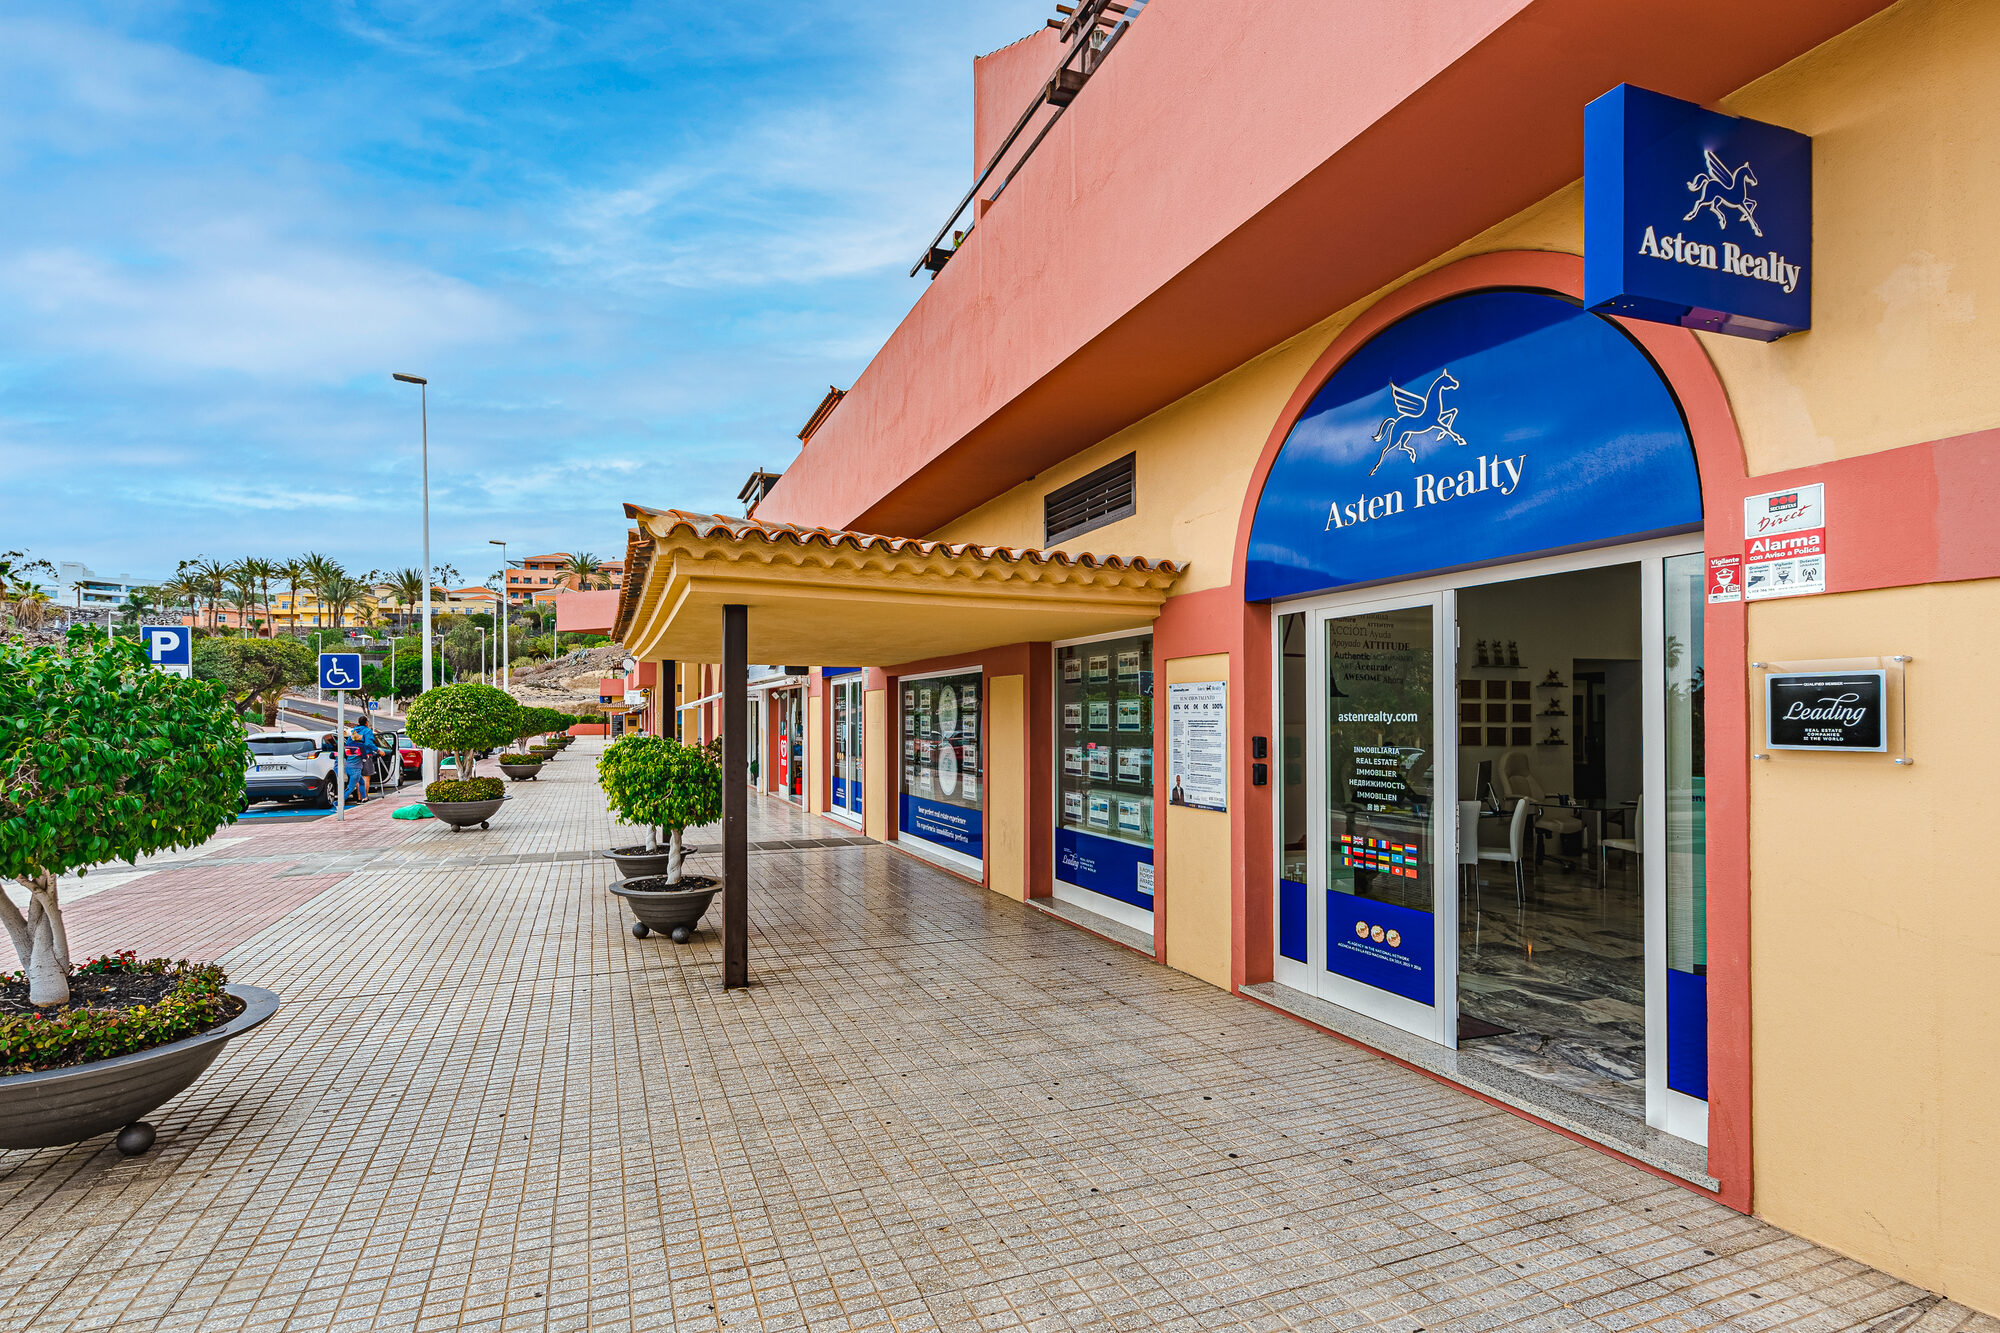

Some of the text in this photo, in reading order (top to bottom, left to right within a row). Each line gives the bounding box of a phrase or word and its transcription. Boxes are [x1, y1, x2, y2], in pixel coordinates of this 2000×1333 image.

[1638, 226, 1801, 294] Asten Realty
[1324, 454, 1526, 532] Asten Realty
[1757, 504, 1812, 532] Direct
[1750, 534, 1820, 554] Alarma
[1764, 551, 1786, 560] Aviso
[1794, 546, 1820, 555] Policía
[1711, 558, 1740, 566] Vigilante
[1330, 622, 1392, 640] Acción Ayuda
[152, 631, 180, 660] P
[1332, 638, 1410, 651] Apoyado ATTITUDE
[1334, 652, 1370, 660] Authentic
[1356, 662, 1392, 672] Accurate
[1344, 674, 1380, 682] AWESOME
[1782, 692, 1867, 727] Leading
[1338, 710, 1418, 724] astenrealty.com
[1353, 746, 1400, 755] INMOBILIARIA
[1356, 757, 1398, 766] REAL ESTATE
[1356, 768, 1398, 778] IMMOBILIER
[1348, 778, 1406, 790] НЕДВИЖИМОСТЬ
[1356, 790, 1398, 801] IMMOBILIEN
